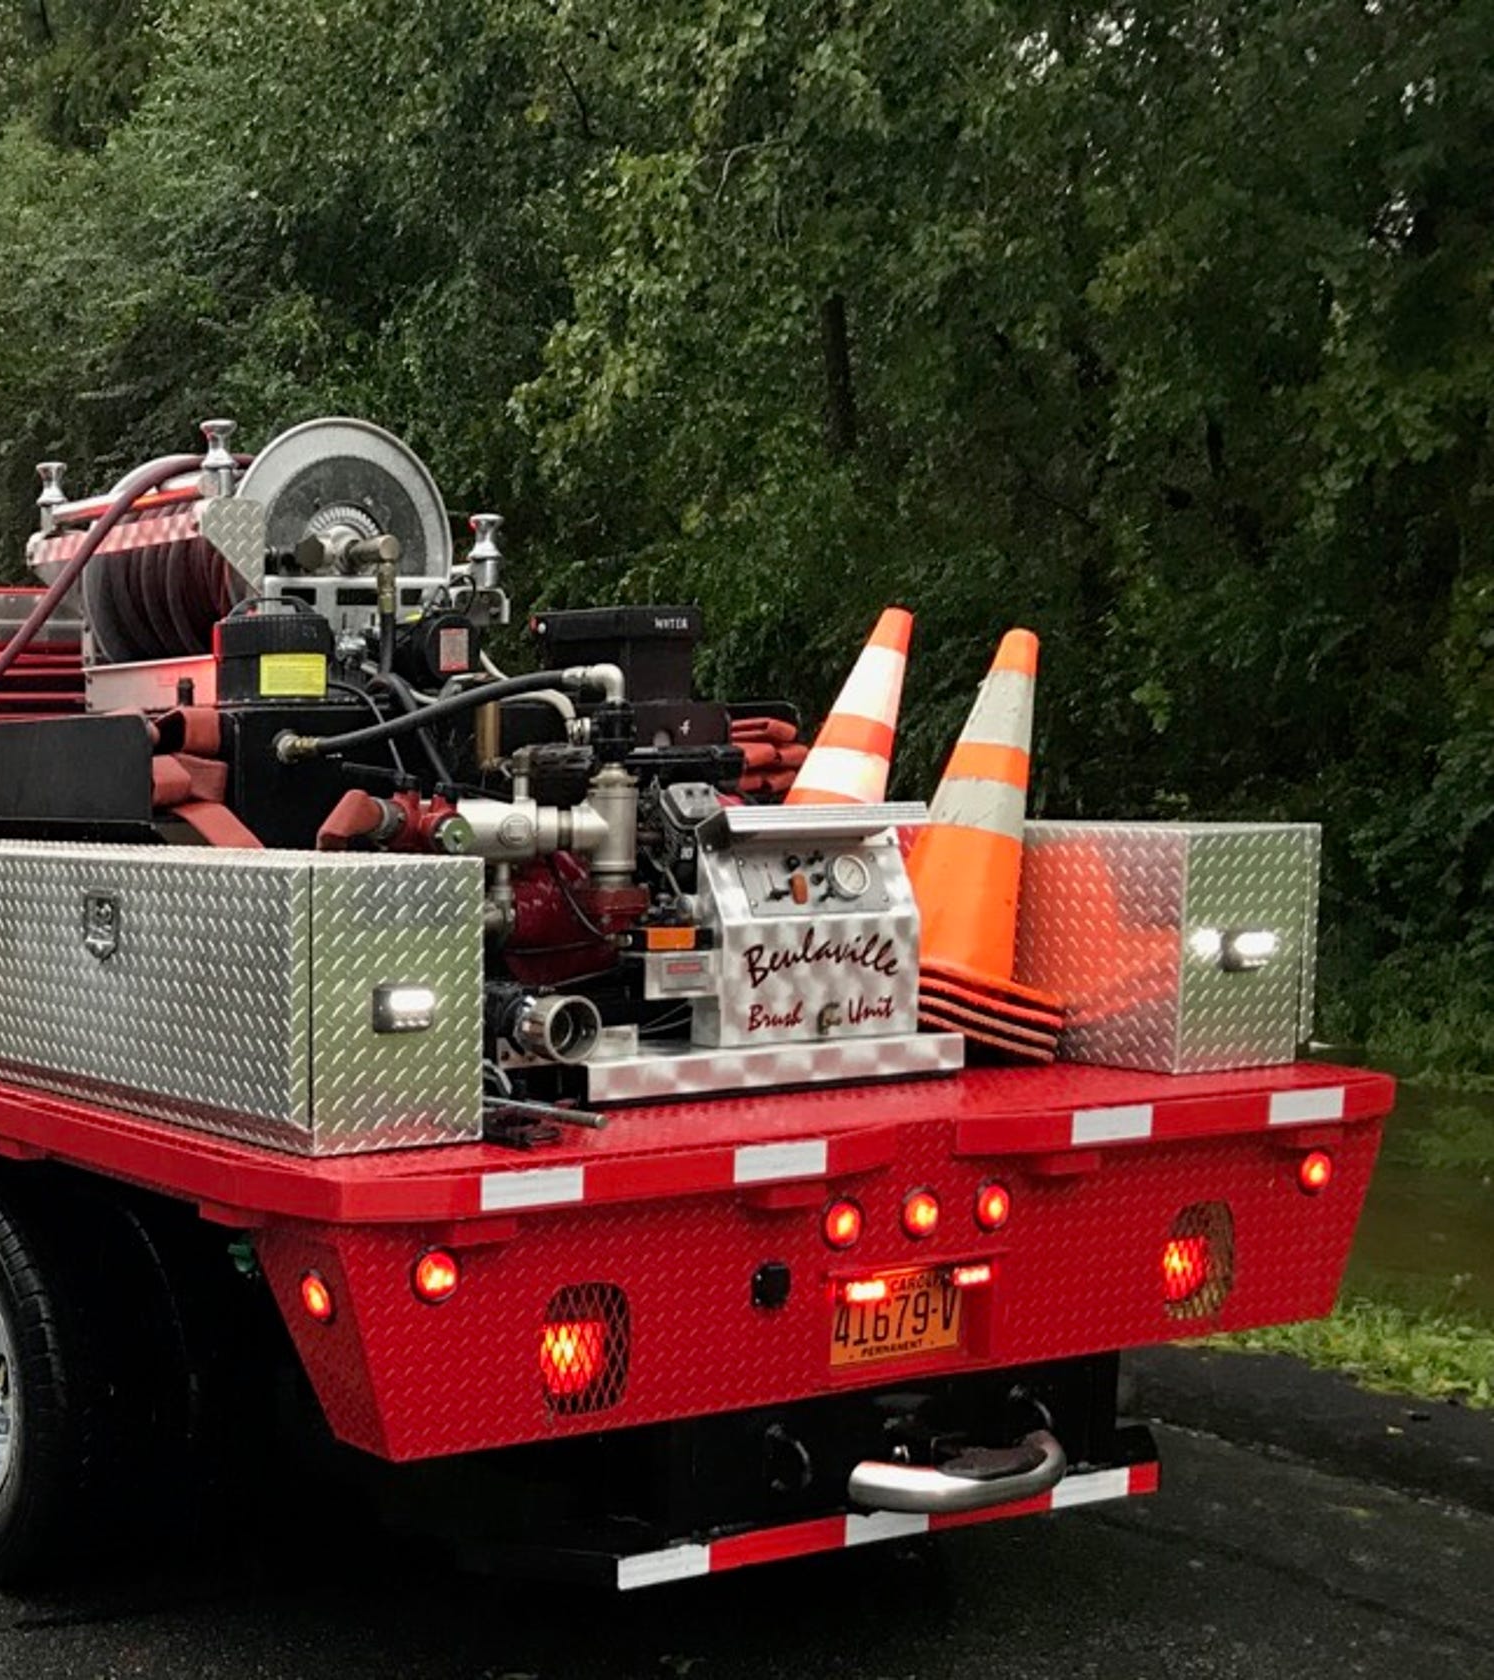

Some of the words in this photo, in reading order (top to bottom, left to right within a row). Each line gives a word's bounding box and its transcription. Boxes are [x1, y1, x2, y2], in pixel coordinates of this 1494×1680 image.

[744, 927, 899, 989] Beulaville
[748, 1001, 804, 1032] Brush
[847, 995, 894, 1025] Unit
[834, 1284, 956, 1348] 41679-V
[860, 1339, 923, 1358] PERMANENT
